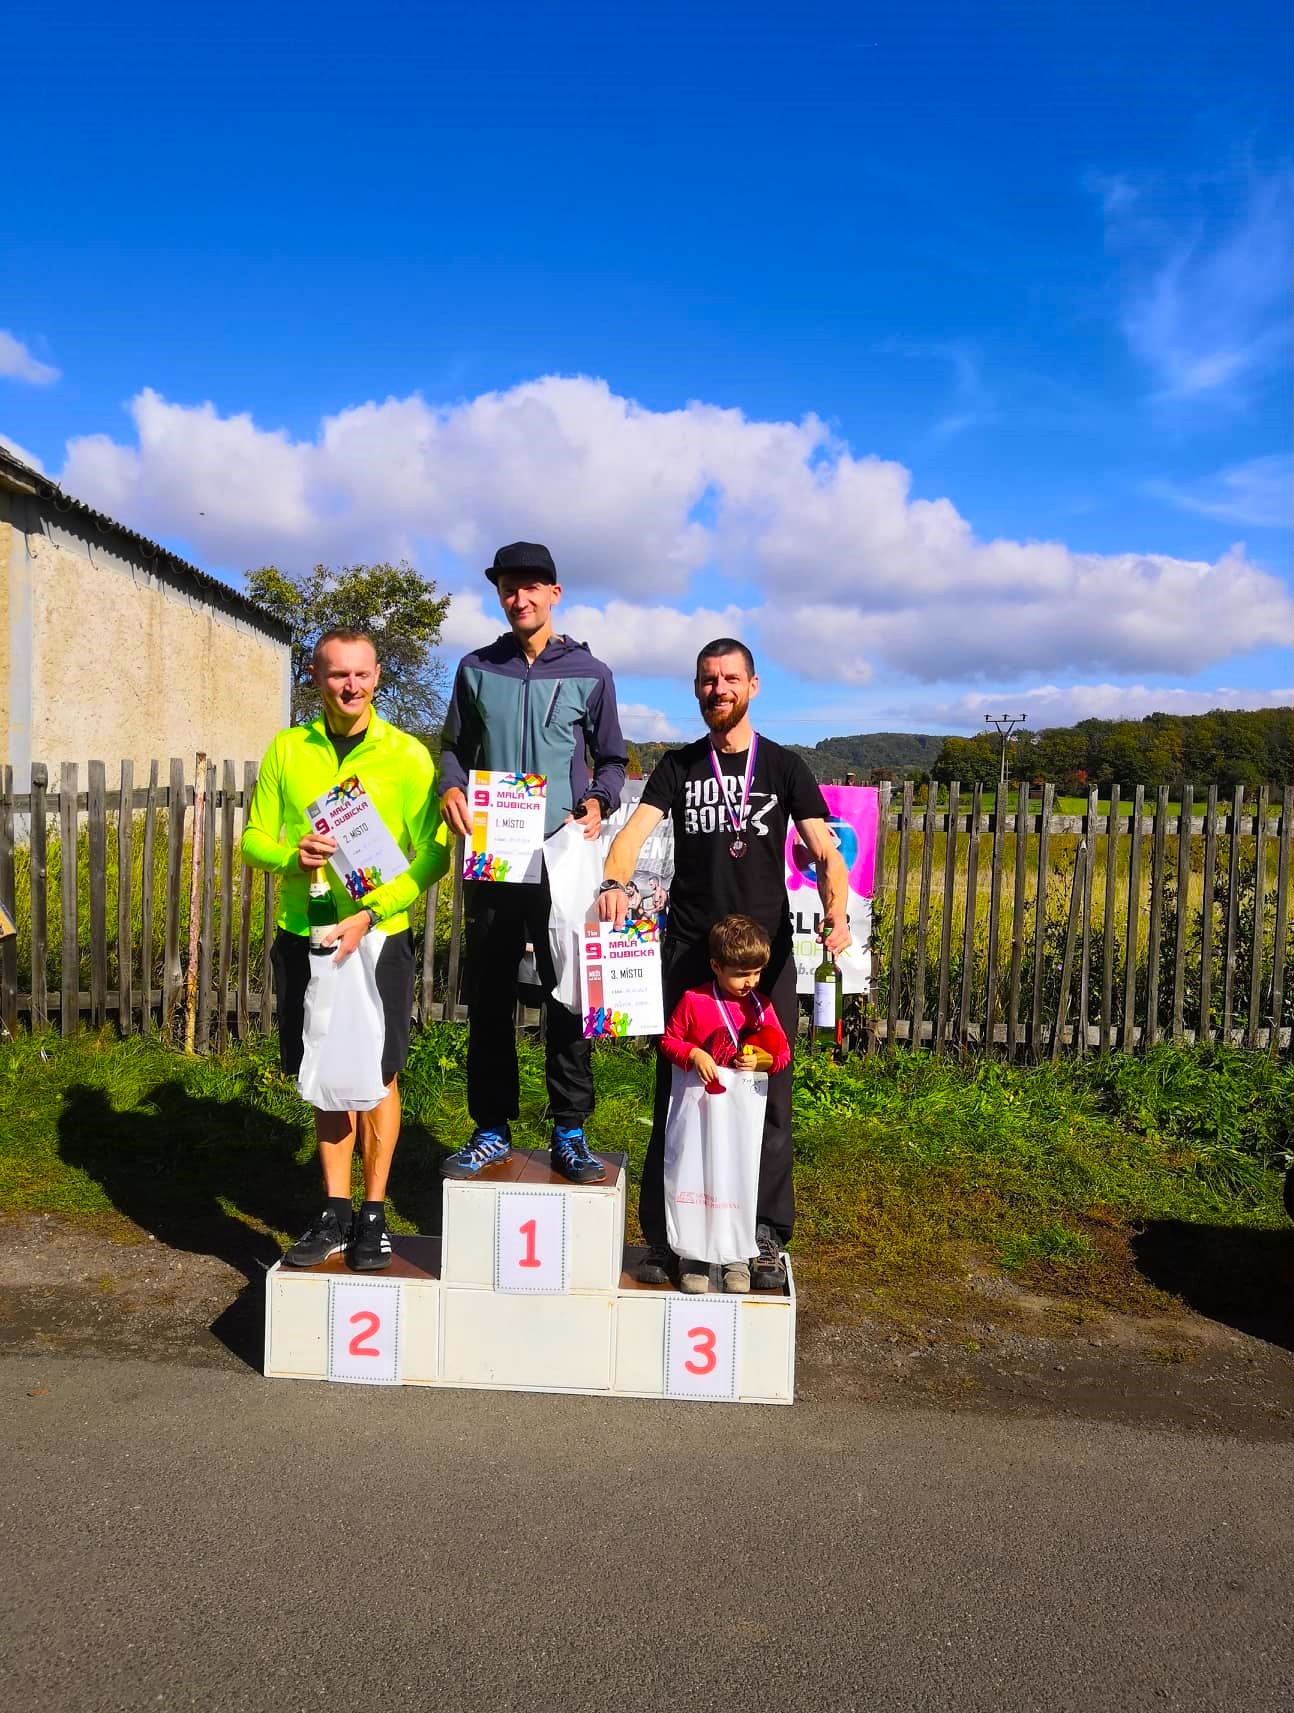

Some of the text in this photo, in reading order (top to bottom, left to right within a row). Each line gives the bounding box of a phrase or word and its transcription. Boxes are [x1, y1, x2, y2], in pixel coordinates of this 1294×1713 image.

[474, 789, 494, 807] 9.
[684, 775, 755, 807] HORY
[314, 816, 334, 836] 9.
[350, 822, 369, 839] MÍSTO
[502, 817, 525, 829] MÍSTO
[585, 942, 607, 960] 9.
[611, 969, 619, 980] 3.
[620, 968, 643, 980] MÍSTO
[519, 1219, 541, 1268] 1
[349, 1311, 380, 1357] 2
[684, 1327, 716, 1375] 3
